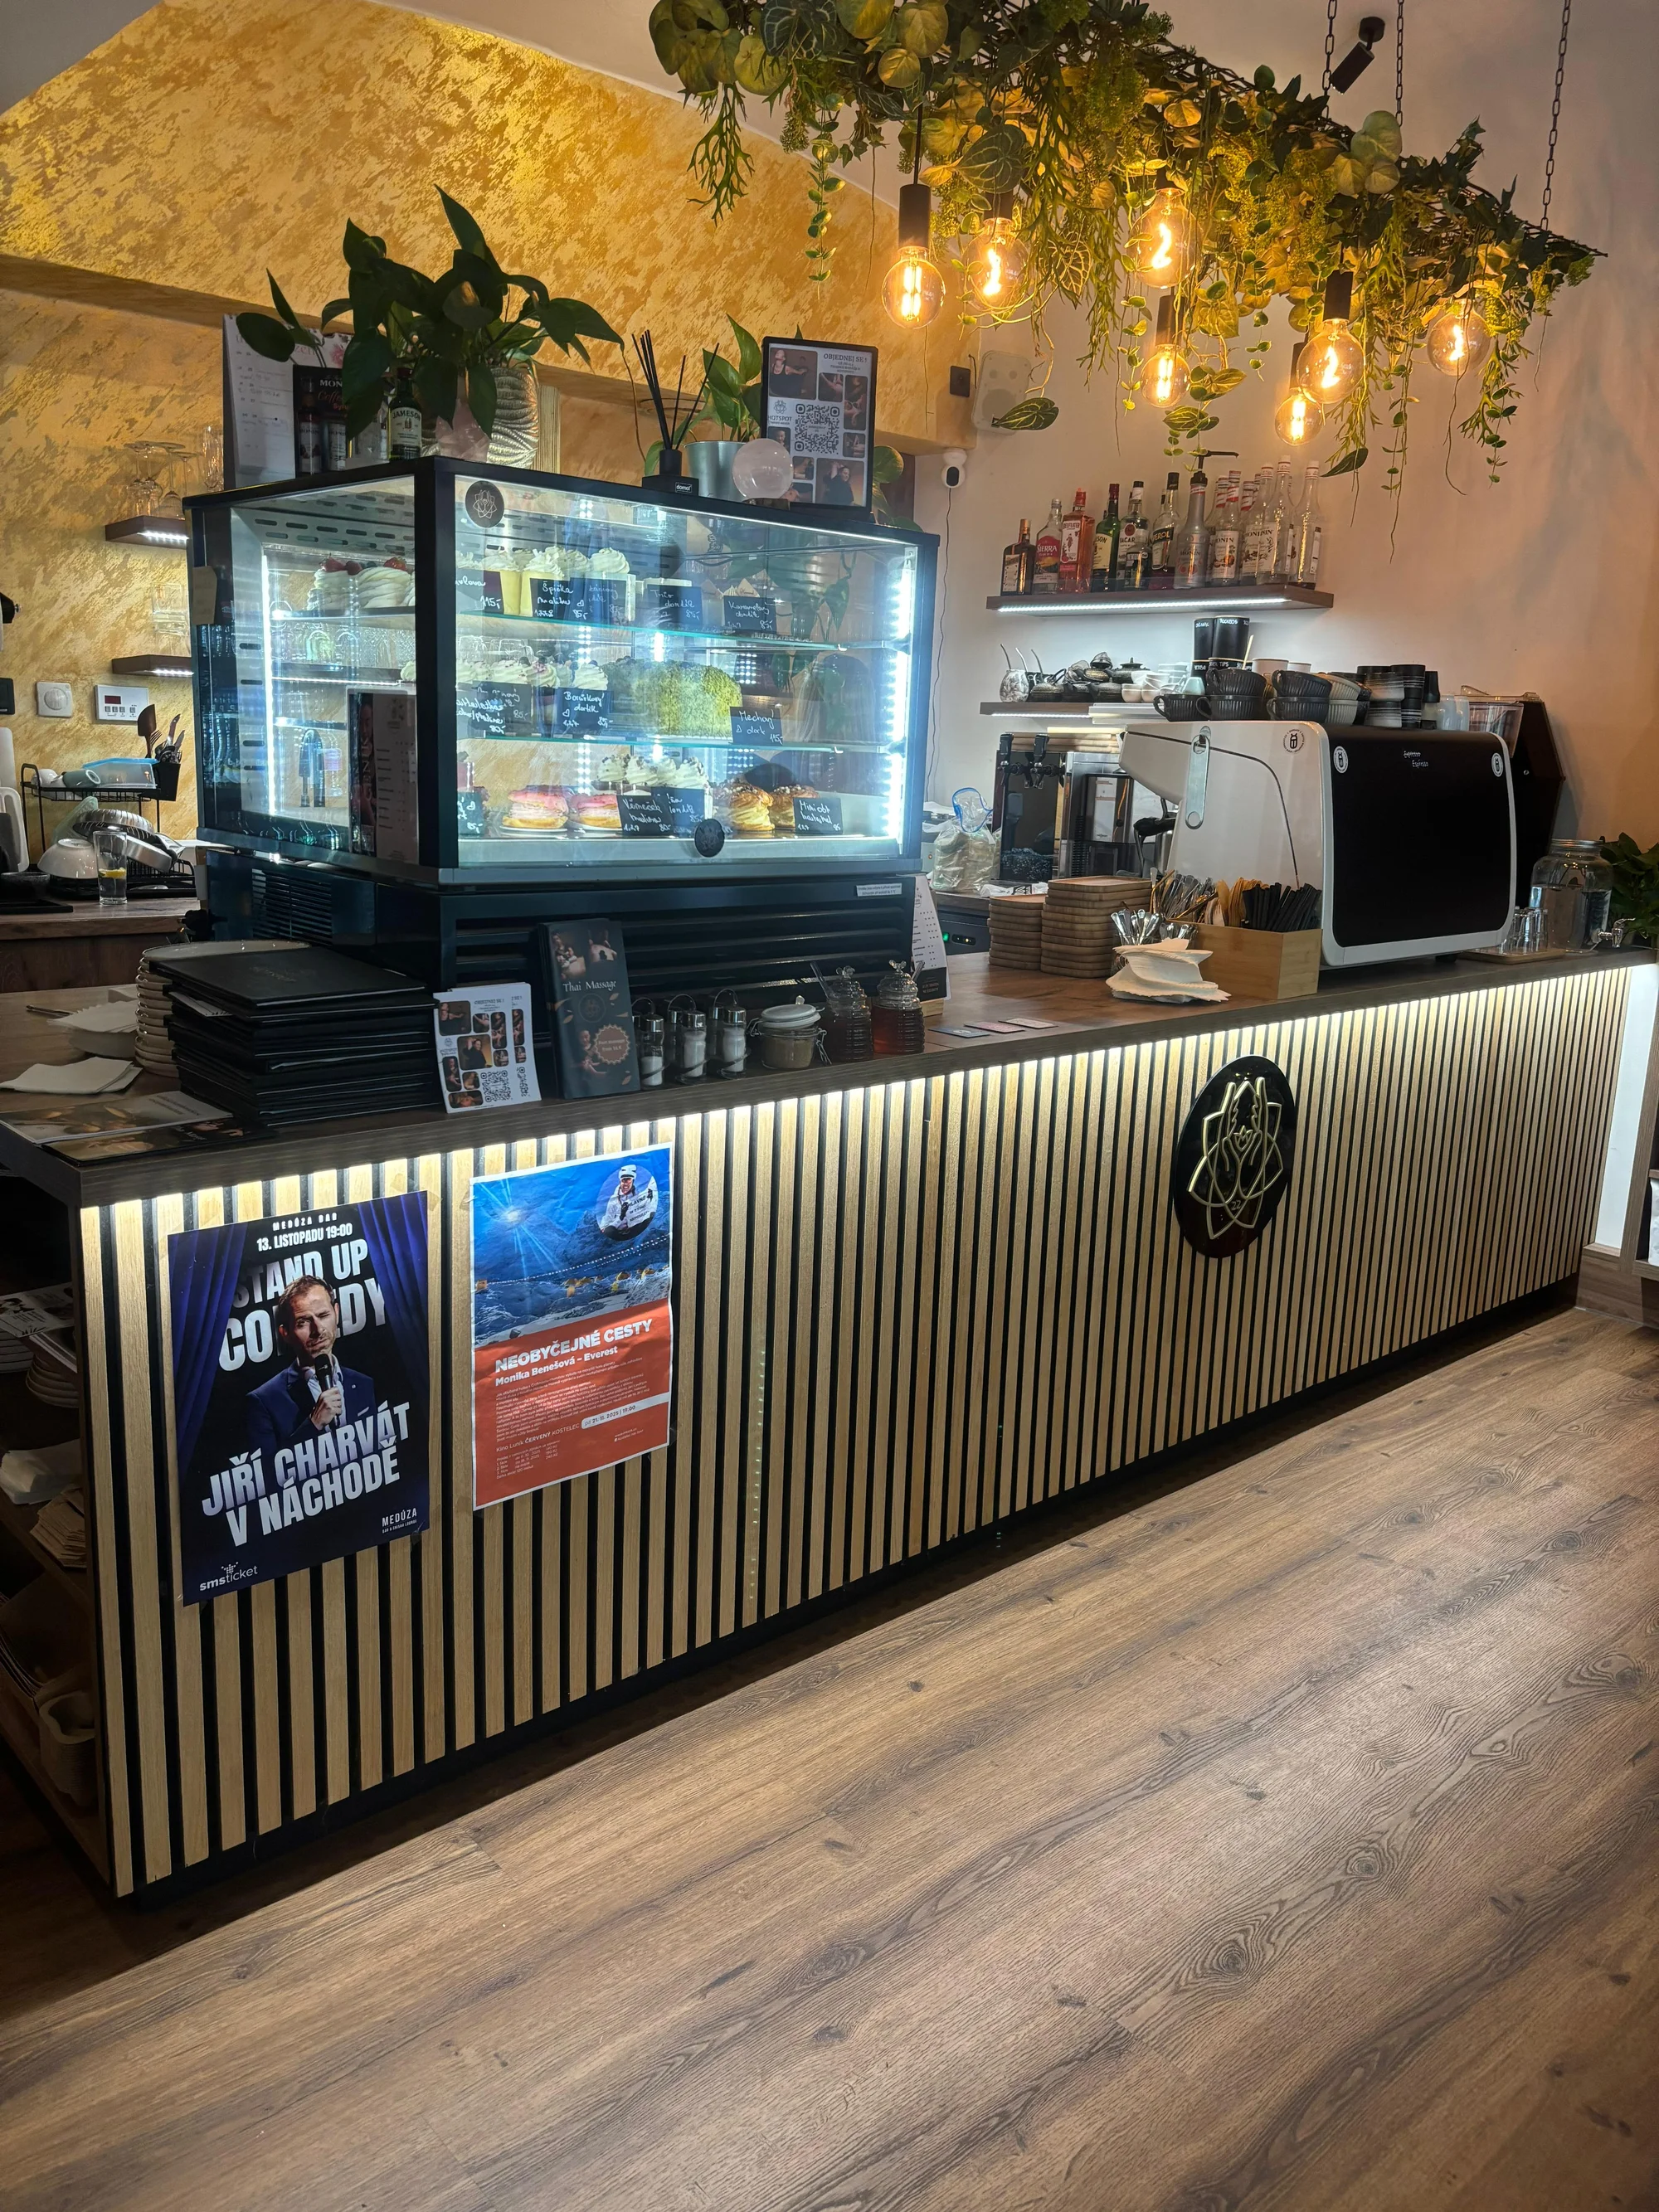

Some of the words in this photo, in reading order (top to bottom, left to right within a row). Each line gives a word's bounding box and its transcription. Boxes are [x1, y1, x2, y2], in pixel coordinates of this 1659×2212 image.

[823, 352, 854, 362] OBJEDNEJ
[392, 409, 421, 421] JAMESON
[1036, 543, 1058, 553] SIERRA
[562, 981, 581, 992] Thai
[586, 980, 616, 991] Massage
[318, 1212, 338, 1224] BAR
[256, 1237, 273, 1252] 13.
[274, 1229, 324, 1249] LISTOPADU
[325, 1223, 353, 1239] 19:00
[330, 1238, 368, 1281] UP
[494, 1330, 601, 1373] NEOBYČEJNÉ
[603, 1319, 653, 1344] CESTY
[495, 1367, 530, 1387] Monika
[531, 1356, 576, 1376] Benešová
[583, 1345, 619, 1362] Everest
[606, 1411, 619, 1419] 2025
[524, 1432, 552, 1444] ČERVENÝ
[552, 1422, 580, 1436] KOSTELEC
[201, 1447, 266, 1517] JIŘÍ
[274, 1400, 411, 1488] CHARVÁT
[226, 1505, 248, 1548] V
[258, 1435, 401, 1536] NÁCHODĚ
[382, 1507, 417, 1528] MEDÚZA
[199, 1564, 259, 1592] smsticket
